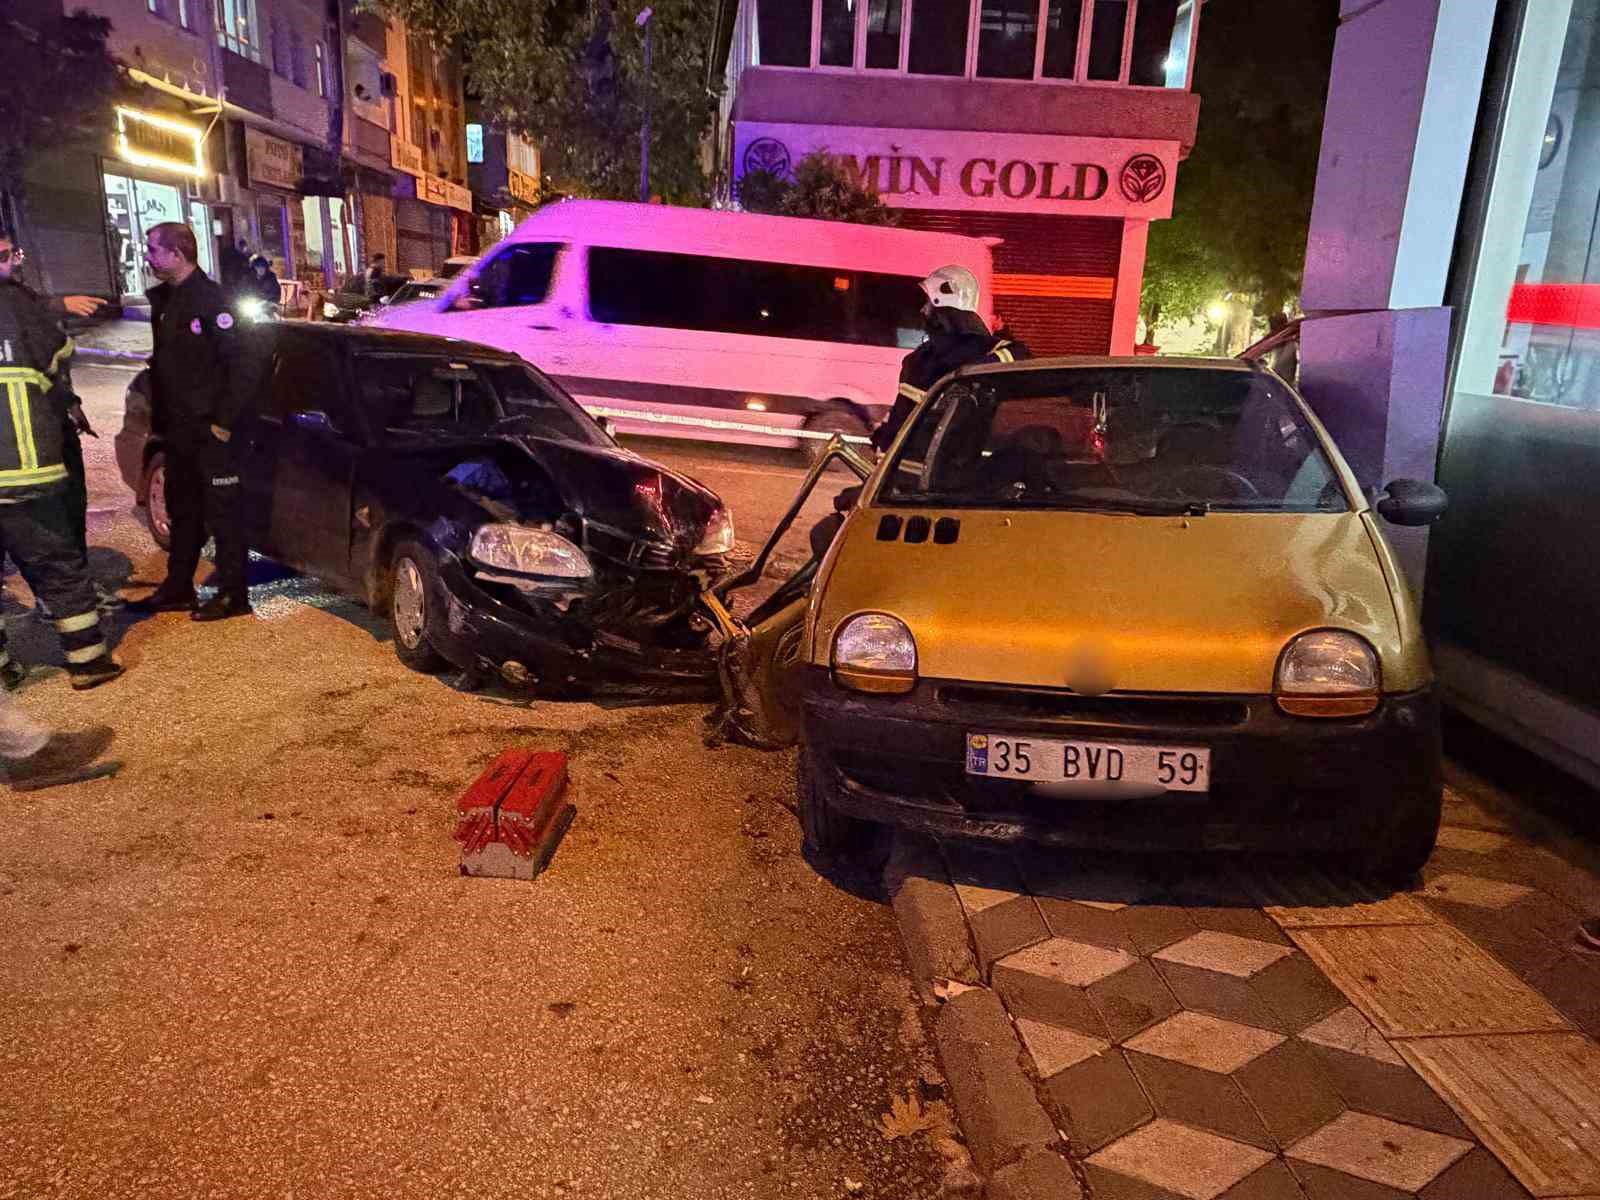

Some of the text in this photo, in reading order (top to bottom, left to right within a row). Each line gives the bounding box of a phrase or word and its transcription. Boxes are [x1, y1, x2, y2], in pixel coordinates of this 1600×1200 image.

[959, 157, 1109, 201] GOLD
[994, 740, 1198, 785] 35 BVD 59
